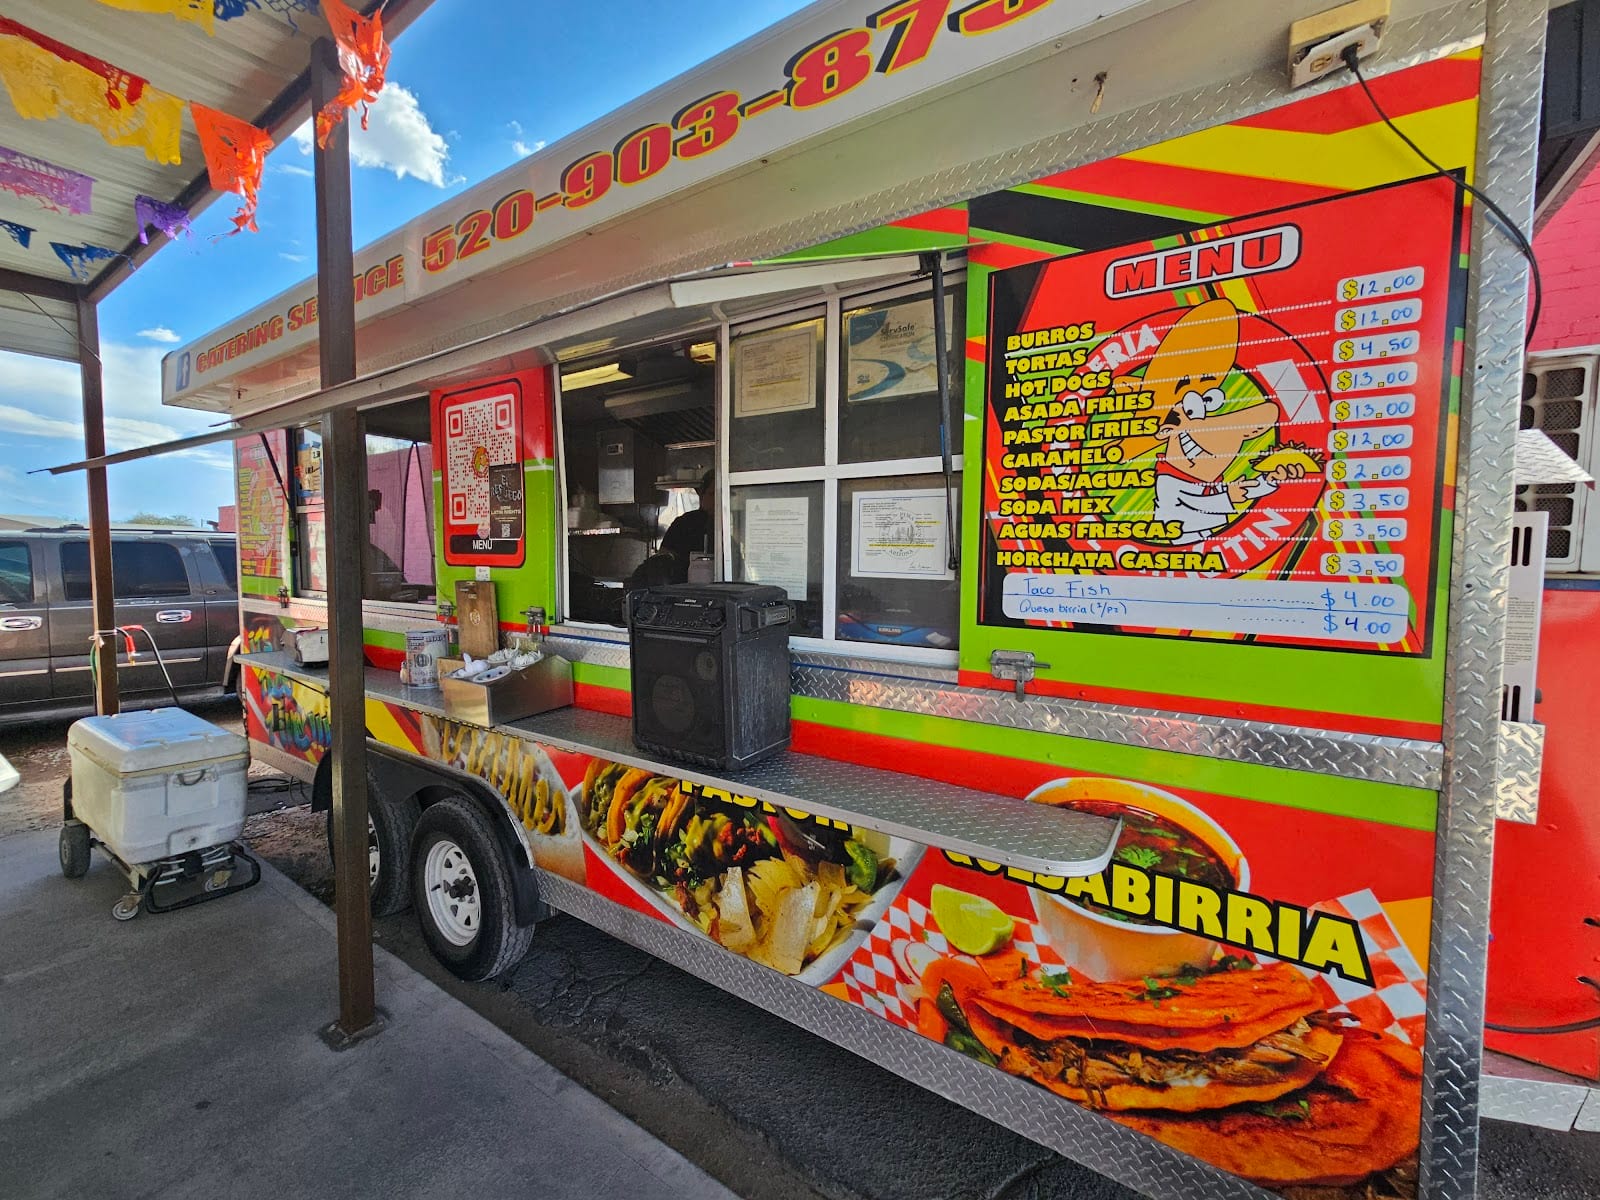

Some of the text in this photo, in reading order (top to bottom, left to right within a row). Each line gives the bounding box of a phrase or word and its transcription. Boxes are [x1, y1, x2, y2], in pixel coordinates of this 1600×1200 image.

[1113, 232, 1283, 294] MENU
[196, 254, 405, 373] CATERING SEICE
[1006, 321, 1096, 351] BURROS
[1005, 348, 1088, 375] TORTAS
[1005, 379, 1047, 399] HOT
[1051, 371, 1112, 394] DOGS
[1003, 400, 1081, 423] ASADA
[1086, 391, 1155, 415] FRIES
[1002, 423, 1086, 446] PASTOR
[1091, 416, 1160, 439] FRIES
[1001, 446, 1124, 470] CARAMELO
[1000, 469, 1157, 494] SODAS/AGUAS
[999, 499, 1057, 517] SODA
[1061, 496, 1114, 516] MEX
[999, 522, 1072, 540] AGUAS
[1075, 520, 1184, 540] FRESCAS
[472, 539, 493, 550] MENU
[996, 550, 1116, 569] HORCHATA
[1119, 551, 1227, 571] CASERA
[1023, 577, 1055, 596] Taco
[1066, 580, 1112, 597] Fish
